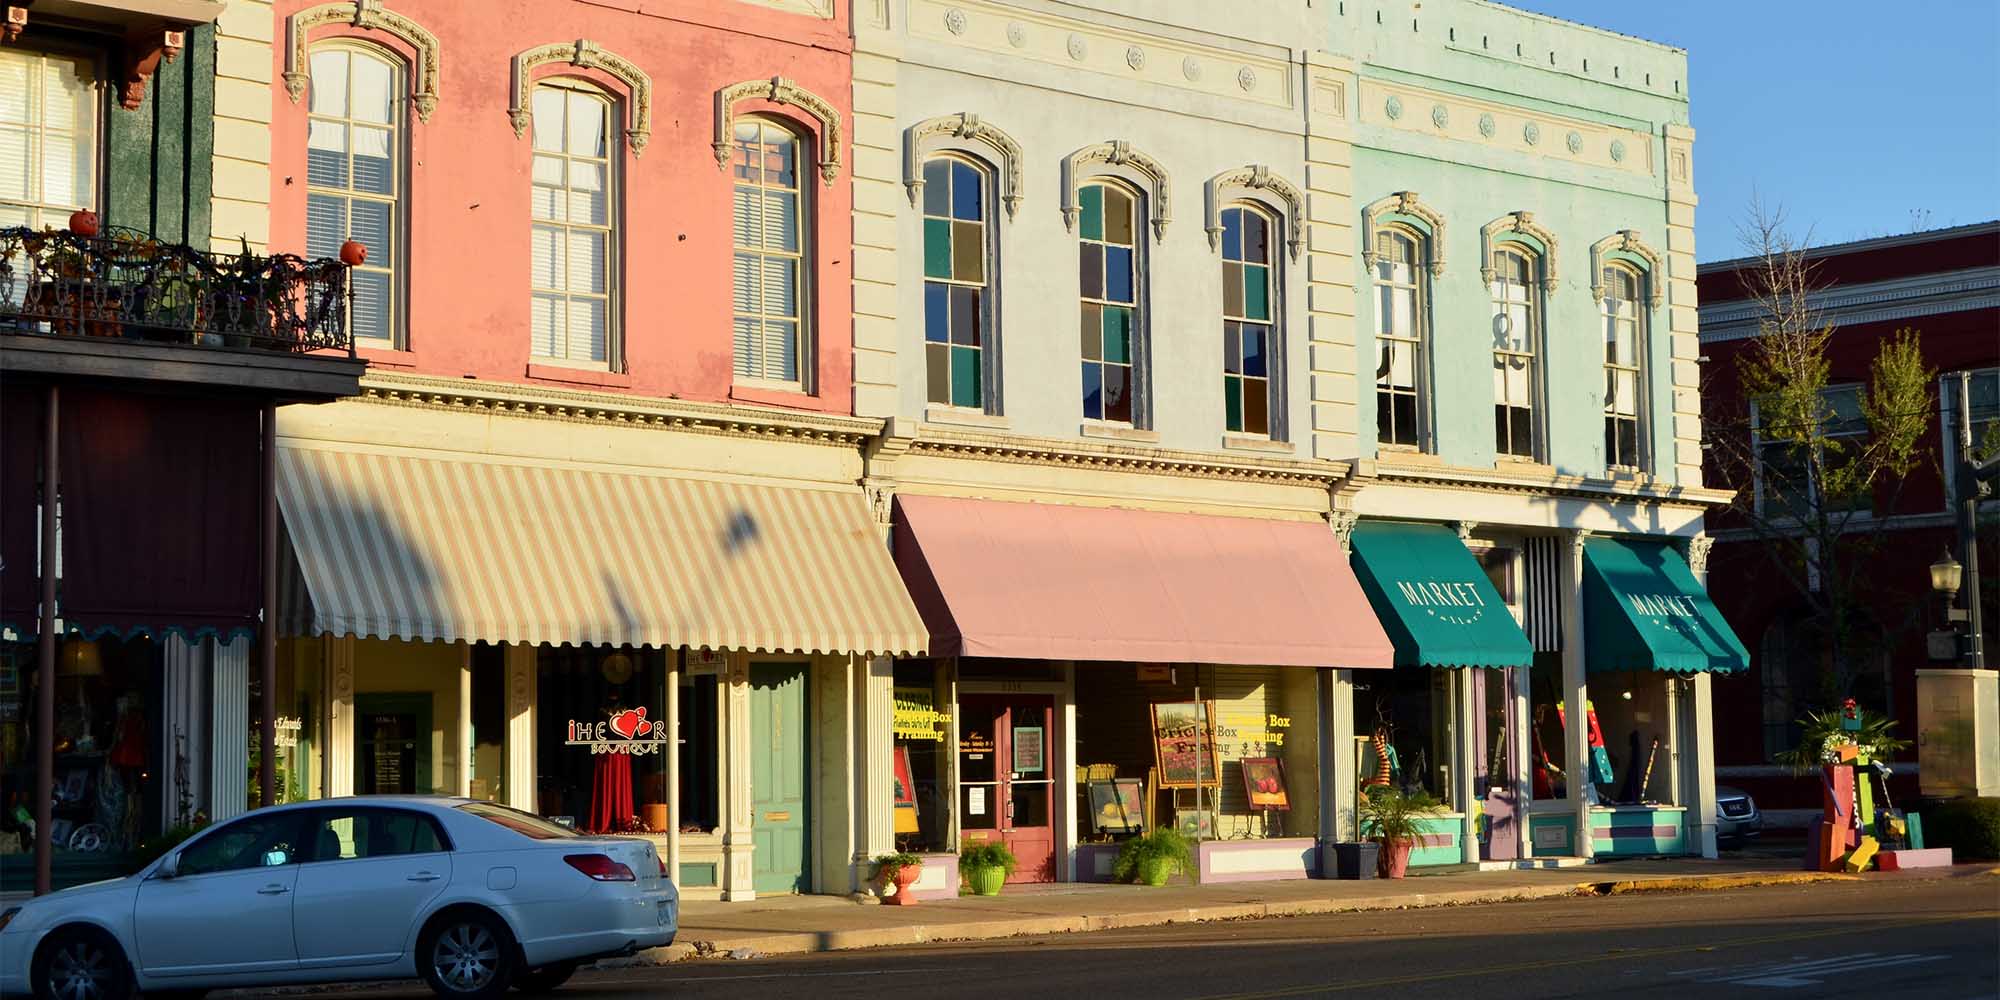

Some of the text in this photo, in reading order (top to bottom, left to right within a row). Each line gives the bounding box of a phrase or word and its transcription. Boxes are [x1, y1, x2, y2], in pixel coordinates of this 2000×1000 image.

[1396, 580, 1485, 607] MARKET
[1626, 592, 1703, 617] MARKET
[932, 711, 953, 723] Box
[1269, 714, 1291, 727] Box
[1217, 725, 1238, 737] Box
[590, 742, 659, 756] BOUTIQUE
